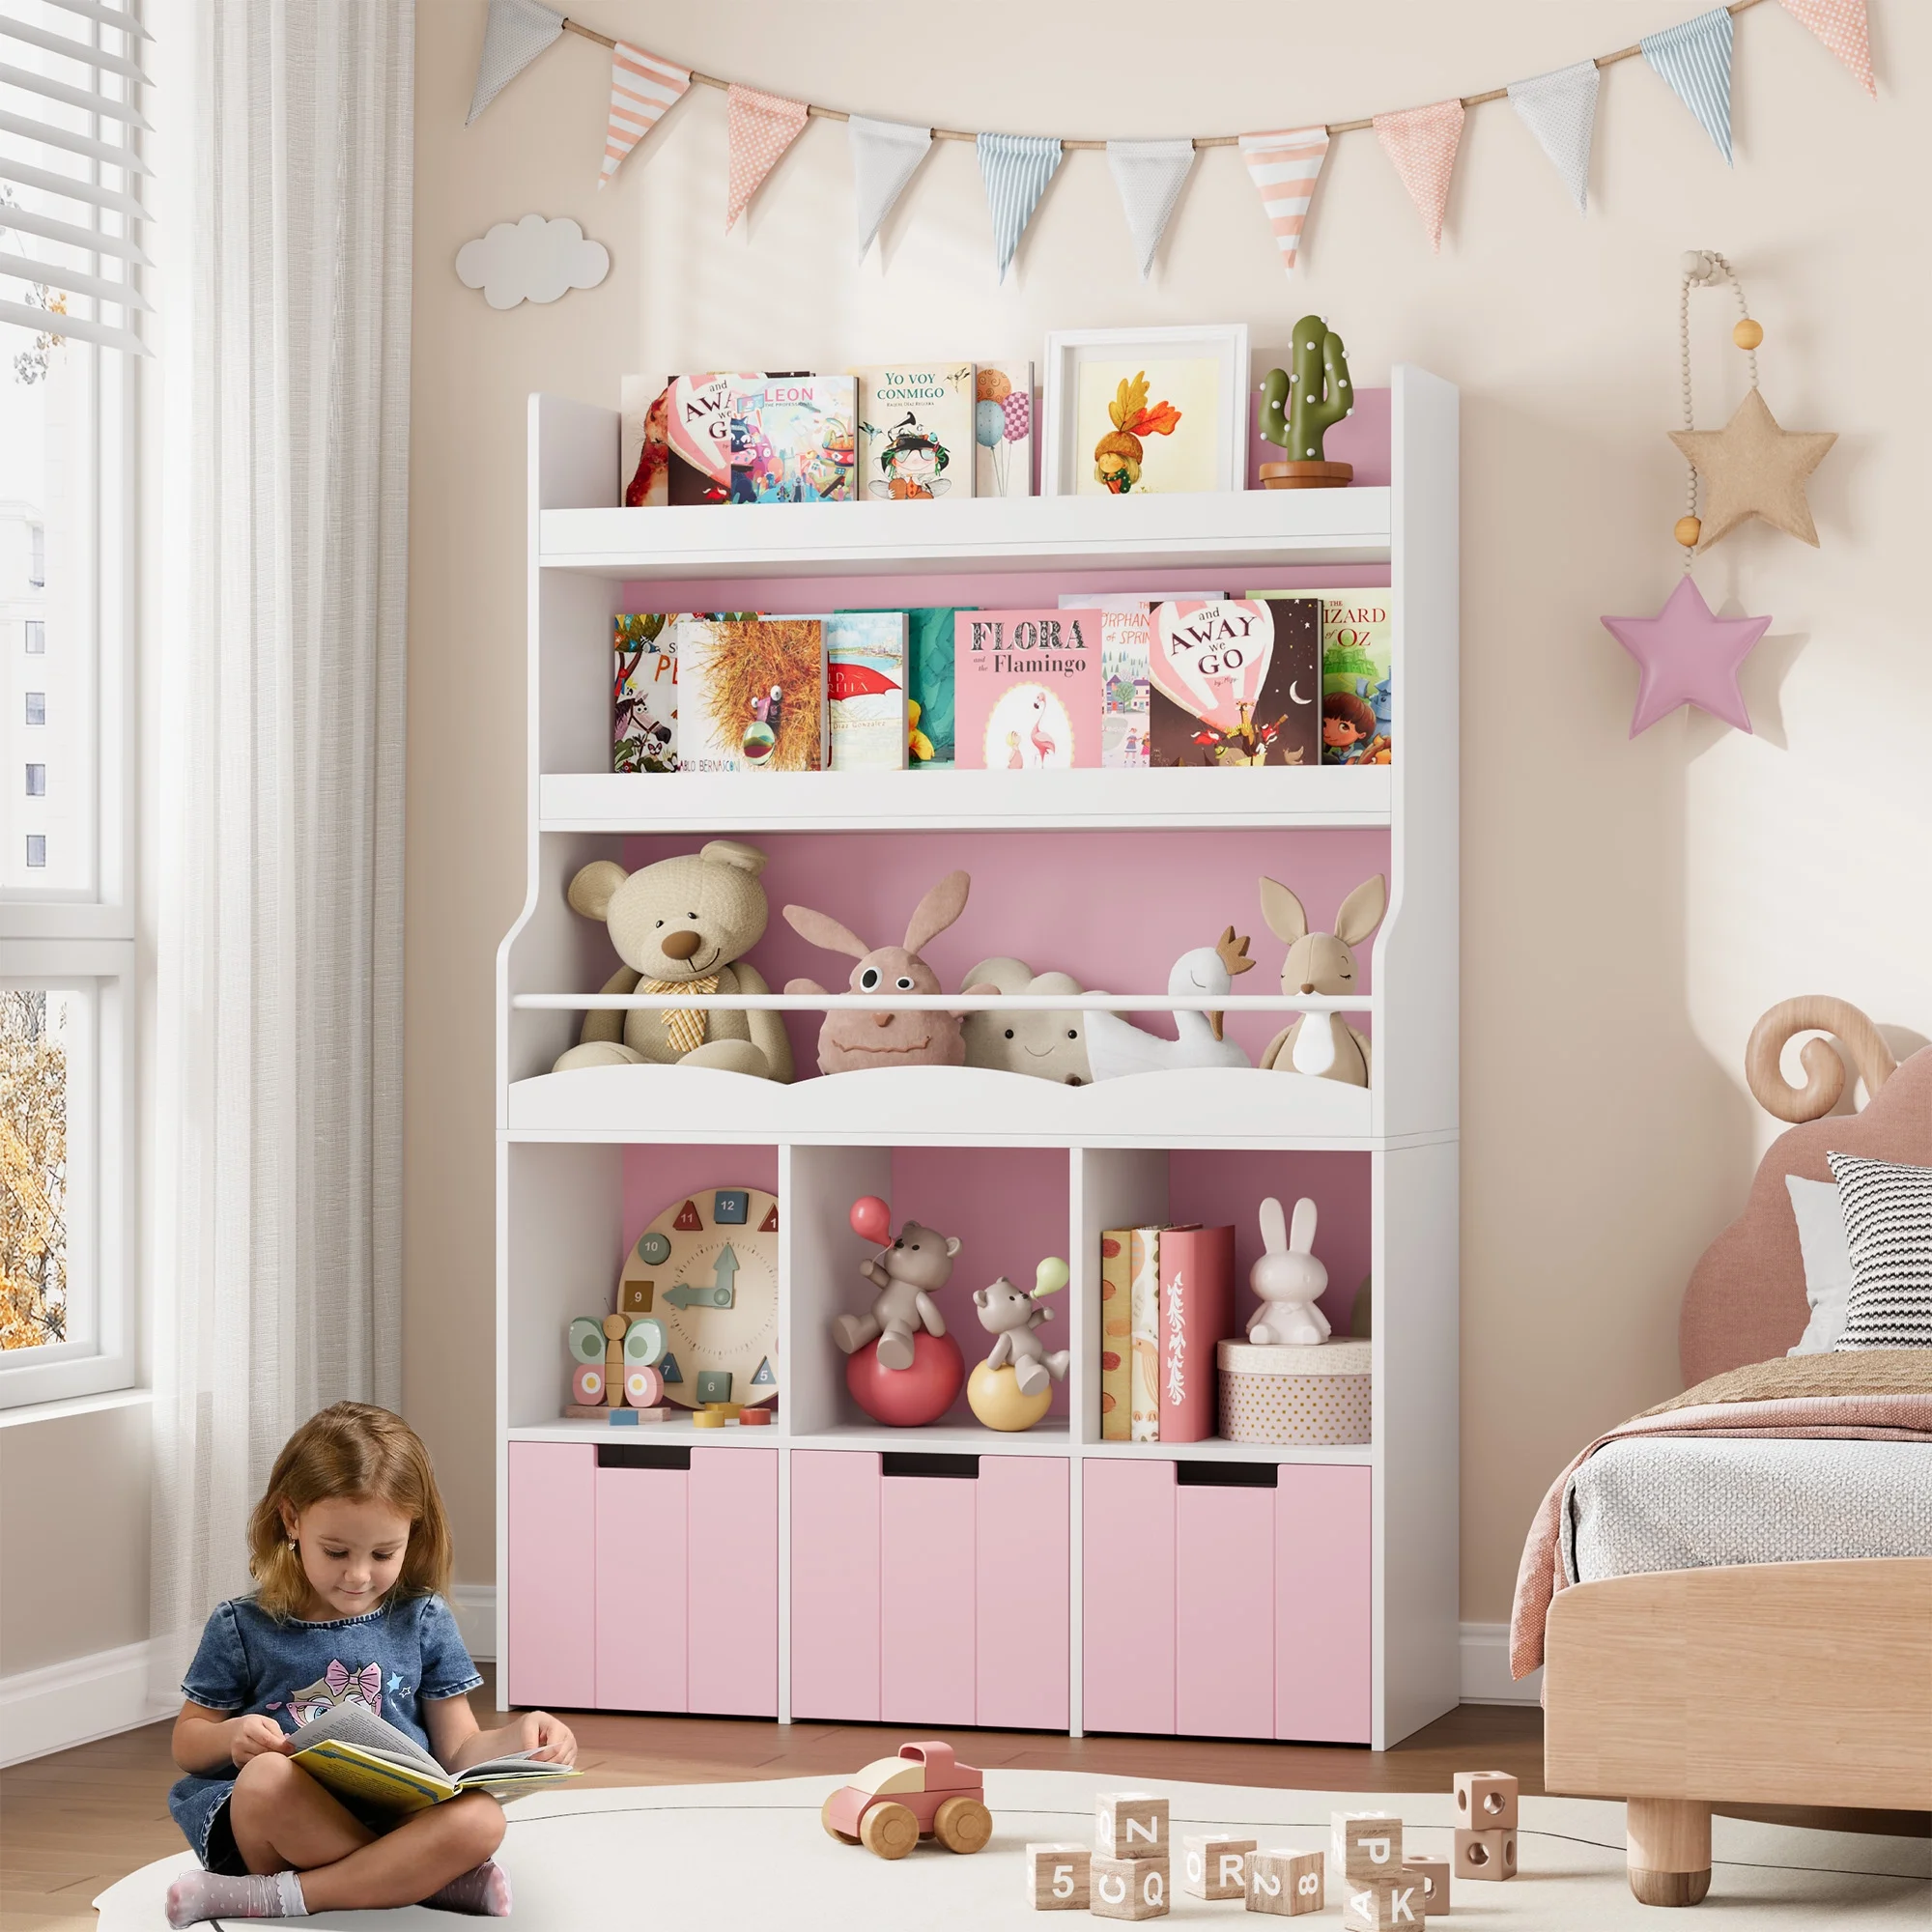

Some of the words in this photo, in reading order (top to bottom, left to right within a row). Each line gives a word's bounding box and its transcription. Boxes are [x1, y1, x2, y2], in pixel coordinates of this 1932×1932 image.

[909, 373, 935, 384] VOY
[709, 380, 727, 392] and
[764, 387, 813, 402] LEON
[877, 387, 945, 400] CONMIGO
[708, 421, 727, 439] G
[1198, 607, 1220, 621] and
[1322, 608, 1386, 624] IZARD
[970, 620, 1089, 652] FLORA
[1106, 632, 1117, 642] of
[1120, 630, 1150, 644] SPRIN
[1170, 615, 1258, 656] AWAY
[1324, 628, 1338, 639] of
[1208, 640, 1226, 653] we
[994, 654, 1087, 678] Flamingo
[1198, 648, 1244, 675] GO
[721, 1200, 735, 1210] 12
[681, 1213, 694, 1223] 11
[644, 1241, 659, 1252] 10
[634, 1291, 642, 1302] 9
[664, 1365, 670, 1376] 7
[759, 1370, 768, 1381] 5
[707, 1382, 715, 1392] 6
[1356, 1837, 1391, 1864] P
[1219, 1854, 1245, 1888] R
[1051, 1864, 1075, 1899] 5
[1298, 1872, 1319, 1896] 8
[1143, 1871, 1164, 1907] Q
[1350, 1889, 1373, 1923] A
[1391, 1887, 1416, 1923] K
